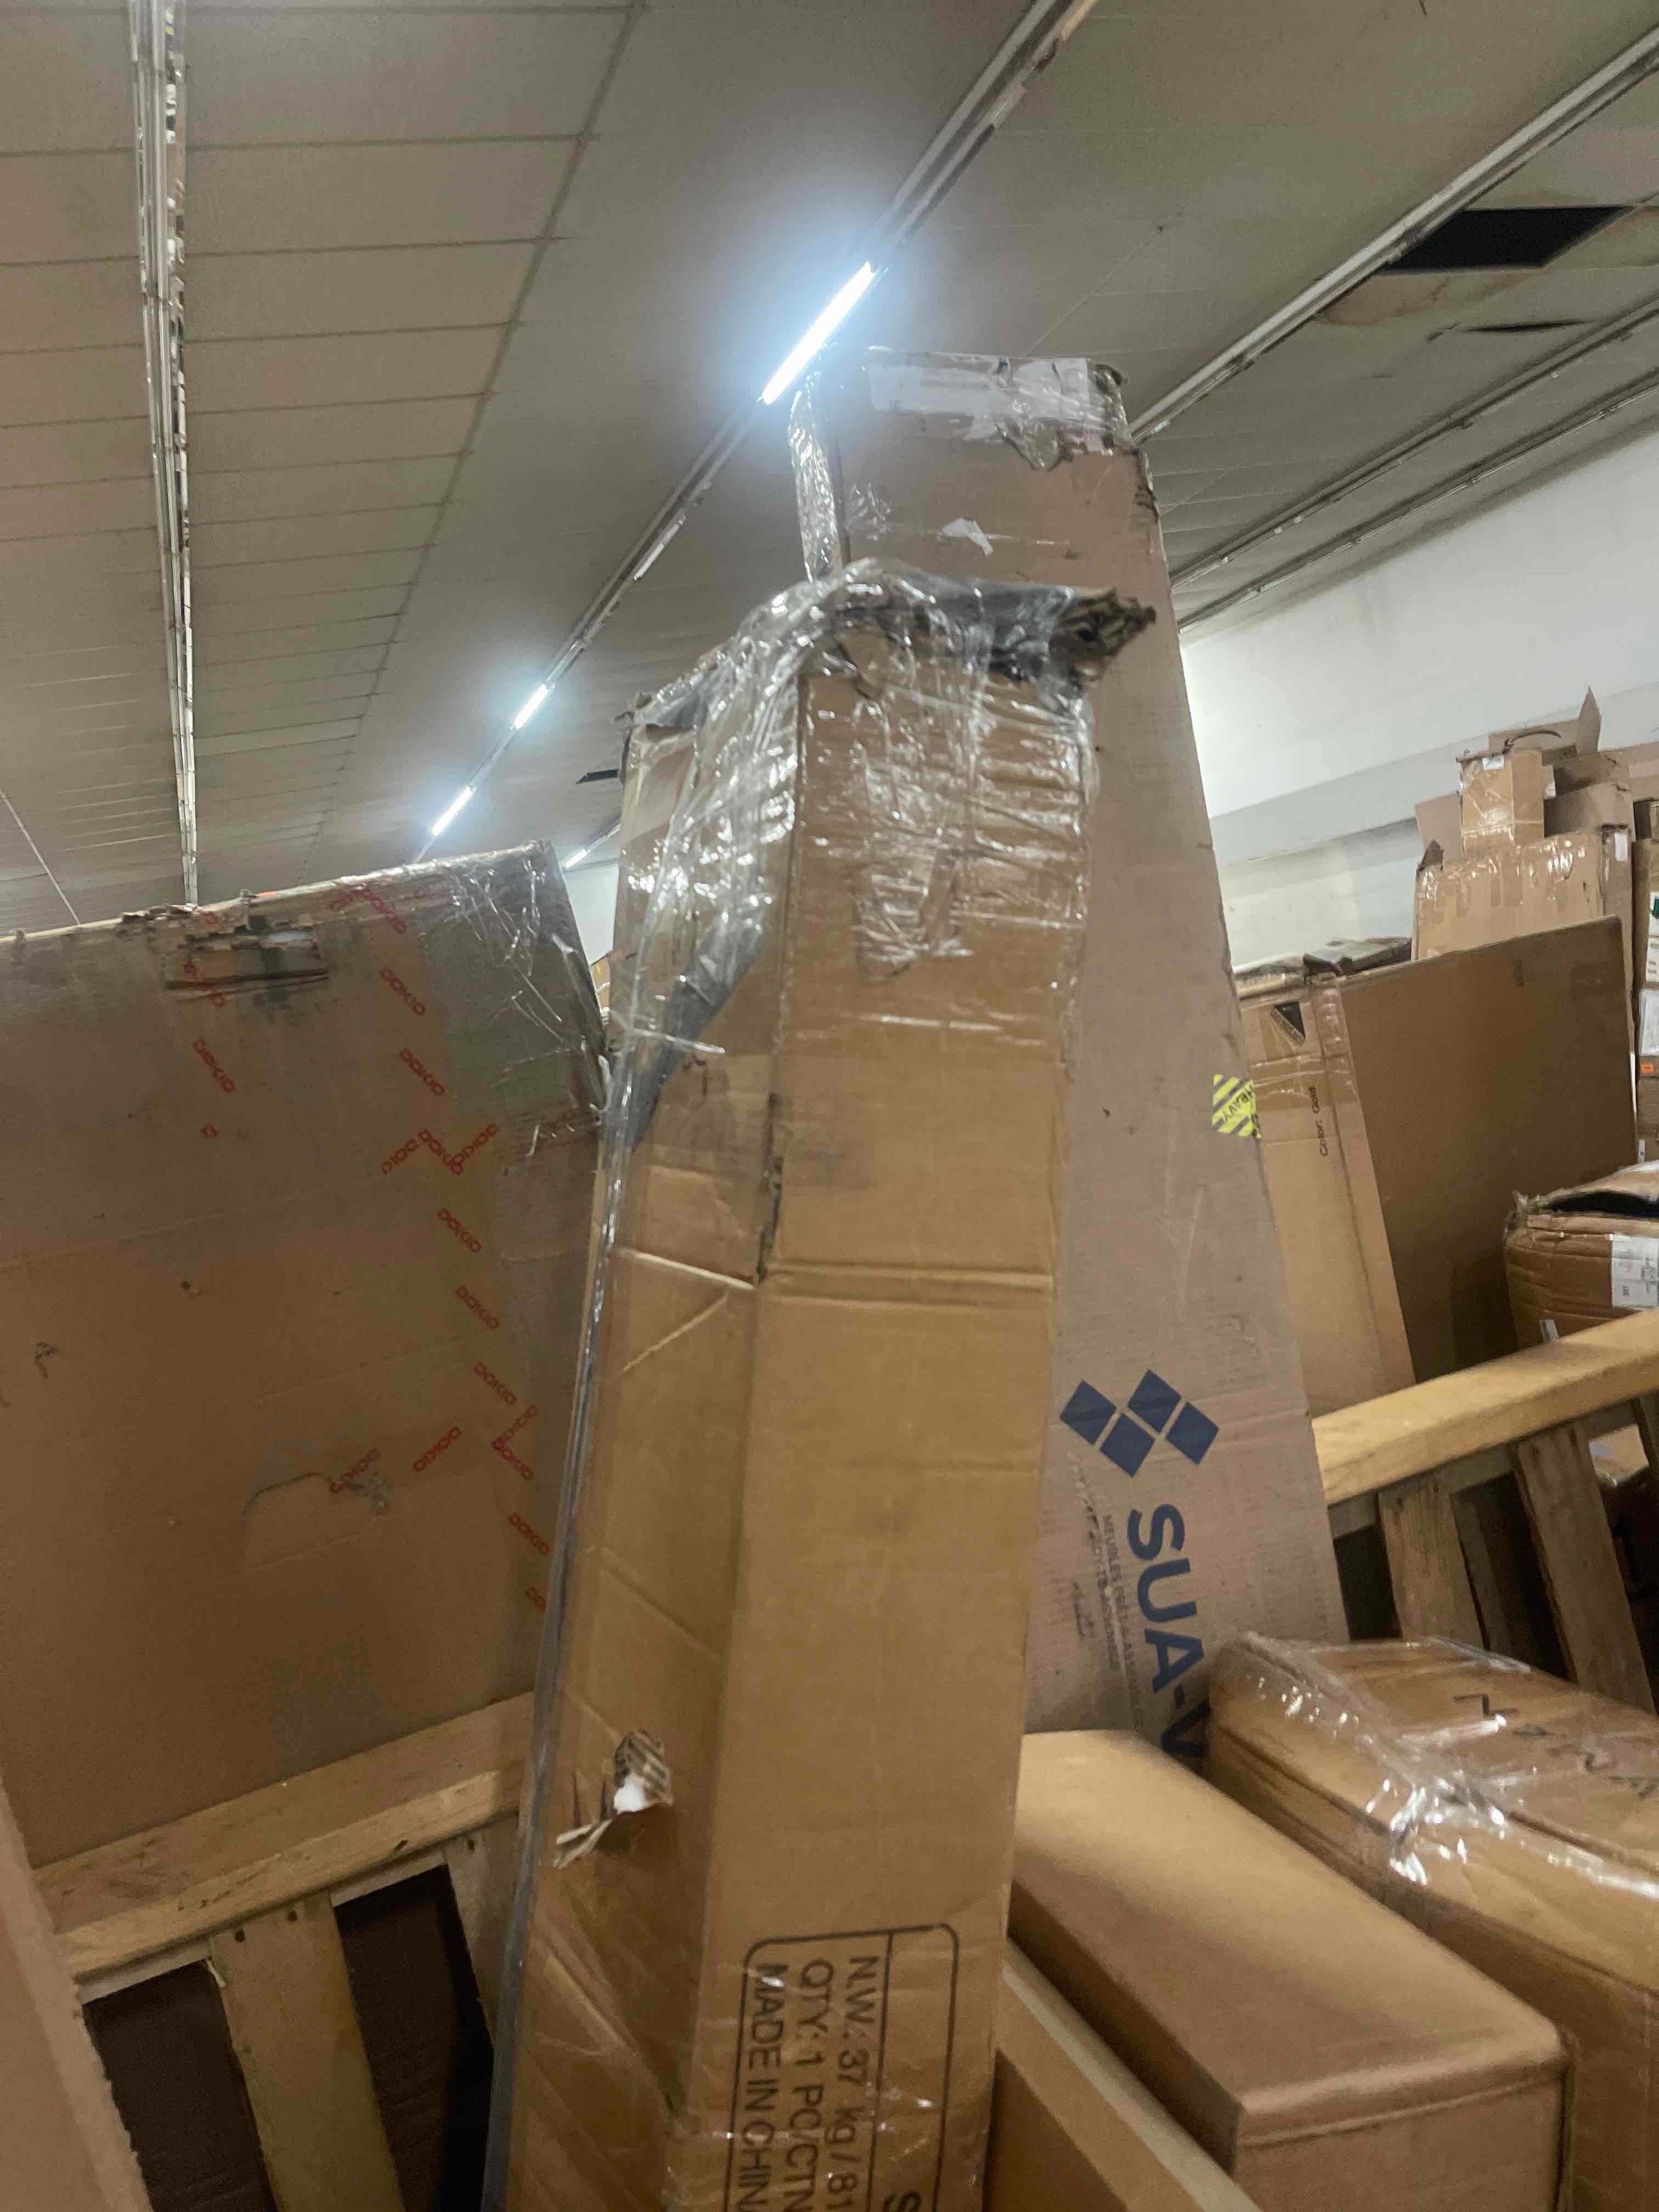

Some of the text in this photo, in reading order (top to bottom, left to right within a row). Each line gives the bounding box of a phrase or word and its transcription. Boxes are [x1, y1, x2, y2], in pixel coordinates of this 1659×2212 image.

[798, 1959, 833, 2039] QTY:
[795, 2051, 823, 2066] 1
[838, 2048, 870, 2085] 37
[738, 1963, 789, 2212] MADE IN CHIN
[826, 2107, 865, 2143] kg
